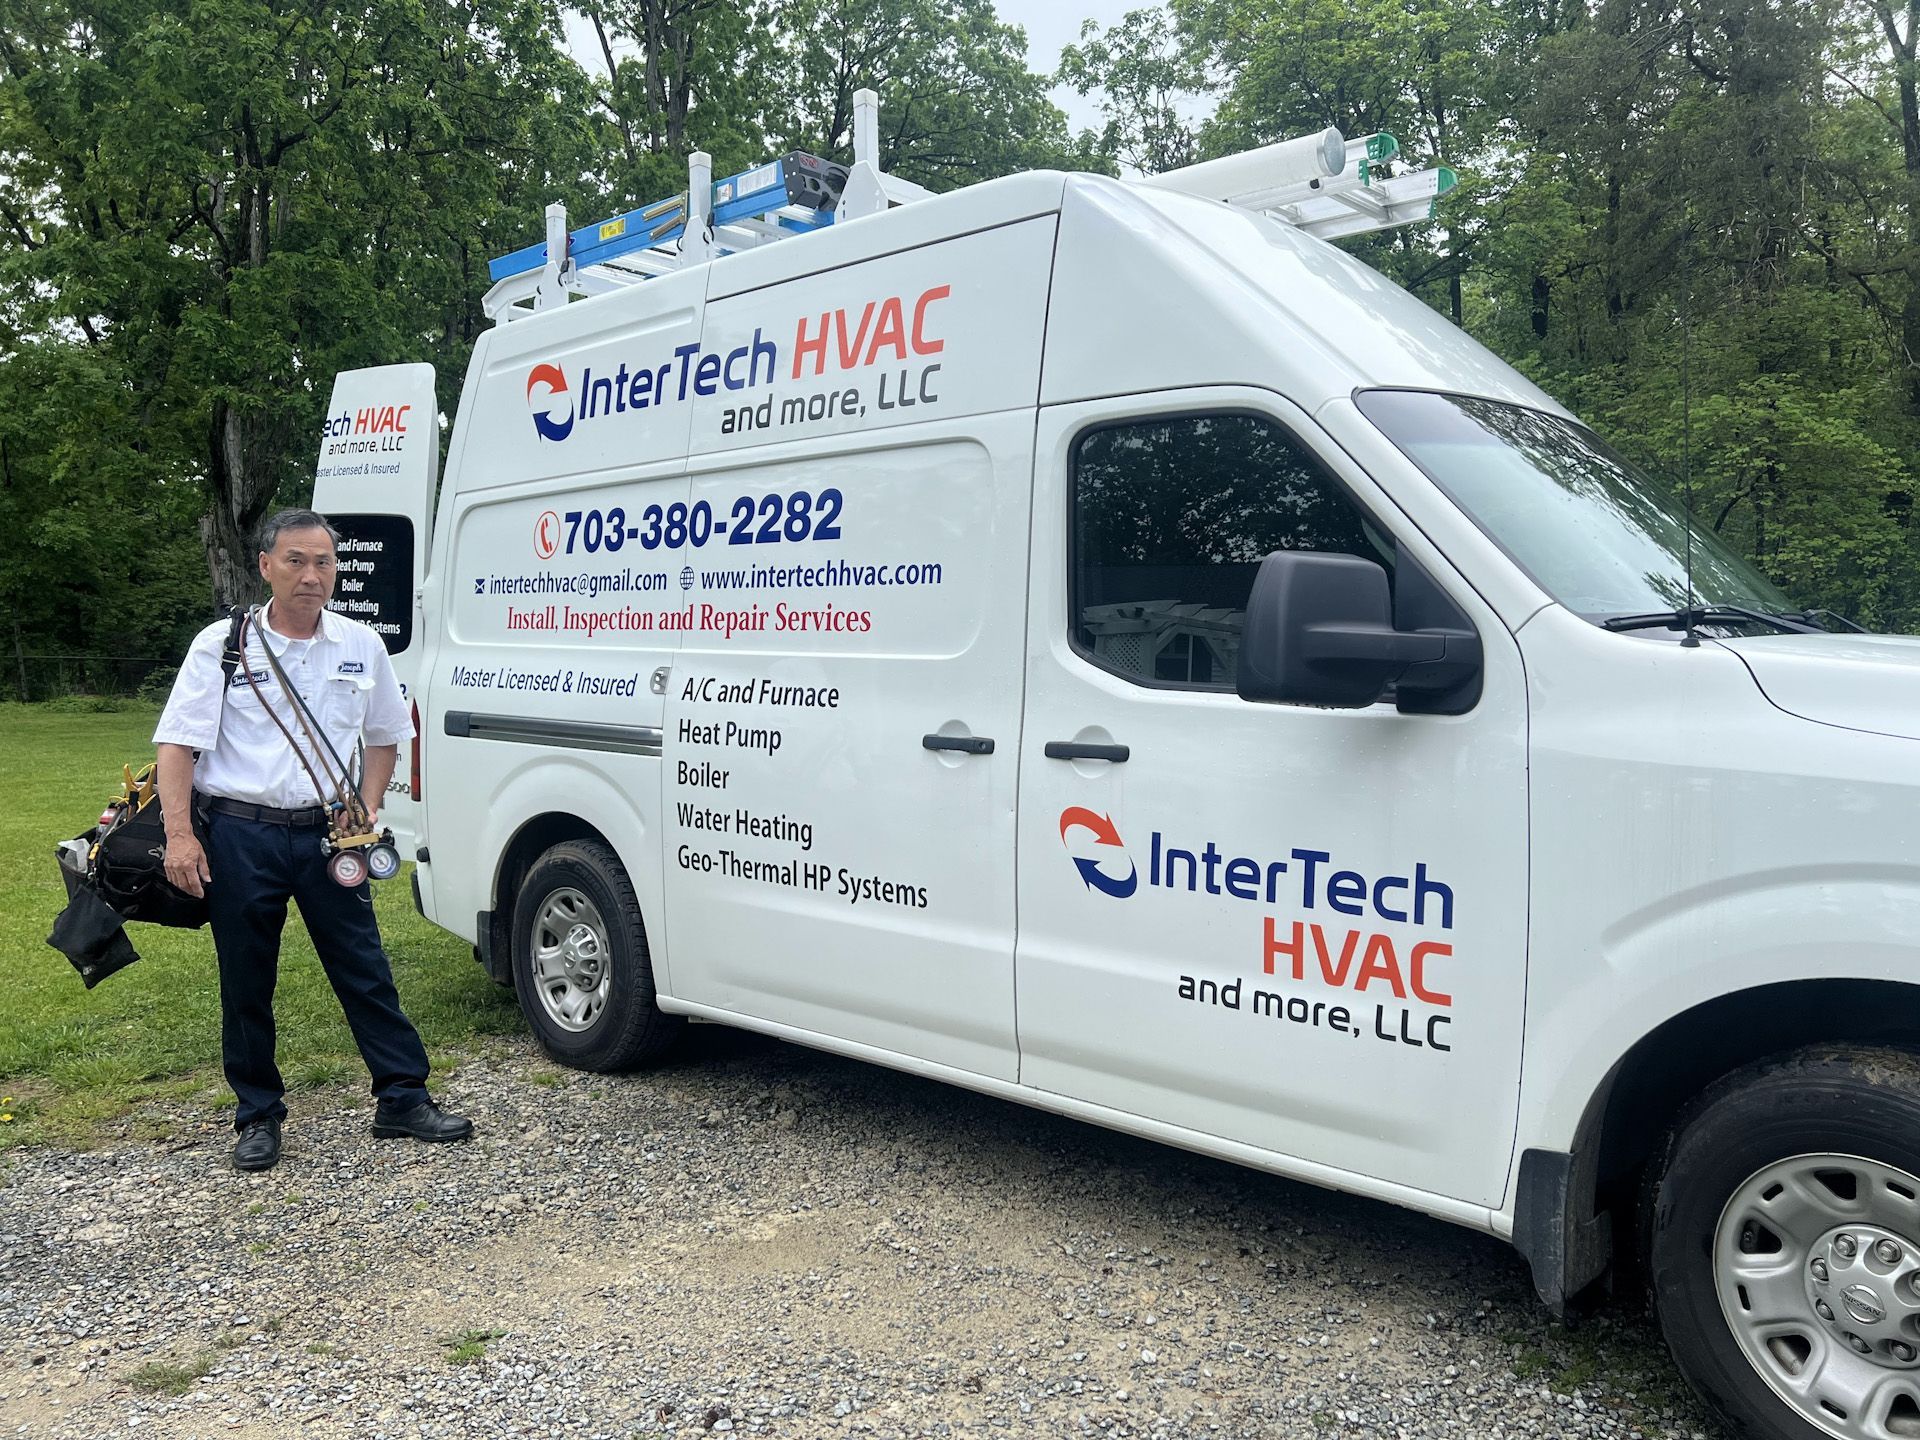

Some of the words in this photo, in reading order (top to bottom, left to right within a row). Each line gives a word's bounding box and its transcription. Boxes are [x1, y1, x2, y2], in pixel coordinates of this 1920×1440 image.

[579, 328, 777, 420] InterTech
[792, 284, 951, 380] HVAC
[721, 393, 773, 434] and
[780, 387, 866, 425] more,
[878, 363, 941, 410] LLC
[354, 405, 411, 435] HVAC
[328, 440, 347, 455] and
[348, 440, 378, 453] more,
[381, 435, 404, 452] LLC
[316, 468, 332, 478] aster
[333, 463, 363, 477] Licensed
[363, 463, 370, 475] &
[370, 462, 401, 474] Insured
[564, 487, 843, 554] 703-380-2282
[337, 538, 351, 552] and
[352, 538, 383, 552] Furnace
[336, 559, 351, 572] Heat
[352, 558, 375, 575] Pump
[701, 559, 942, 590] www.intertechhvac.com
[341, 578, 364, 592] Boiler
[489, 567, 668, 598] intertechhvac@gmail.com
[327, 598, 348, 612] Water
[348, 598, 379, 616] Heating
[507, 606, 559, 633] Install,
[563, 605, 653, 638] Inspection
[659, 603, 694, 632] and
[699, 603, 769, 640] Repair
[775, 602, 872, 633] Services
[451, 666, 496, 688] Master
[497, 667, 562, 692] Licensed
[562, 670, 574, 693] &
[576, 671, 638, 697] Insured
[681, 677, 716, 703] A/C
[717, 678, 756, 704] and
[758, 679, 840, 708] Furnace
[679, 718, 721, 746] Heat
[725, 721, 782, 757] Pump
[677, 760, 730, 789] Boiler
[677, 802, 731, 833] Water
[736, 809, 813, 851] Heating
[678, 845, 798, 887] Geo-Thermal
[803, 862, 832, 892] HP
[837, 868, 928, 909] Systems
[1150, 831, 1454, 930] InterTech
[1263, 916, 1453, 1007] HVAC
[1178, 975, 1242, 1010] and
[1253, 990, 1361, 1038] more,
[1375, 1004, 1452, 1053] LLC
[1844, 1294, 1881, 1316] NISSAN
